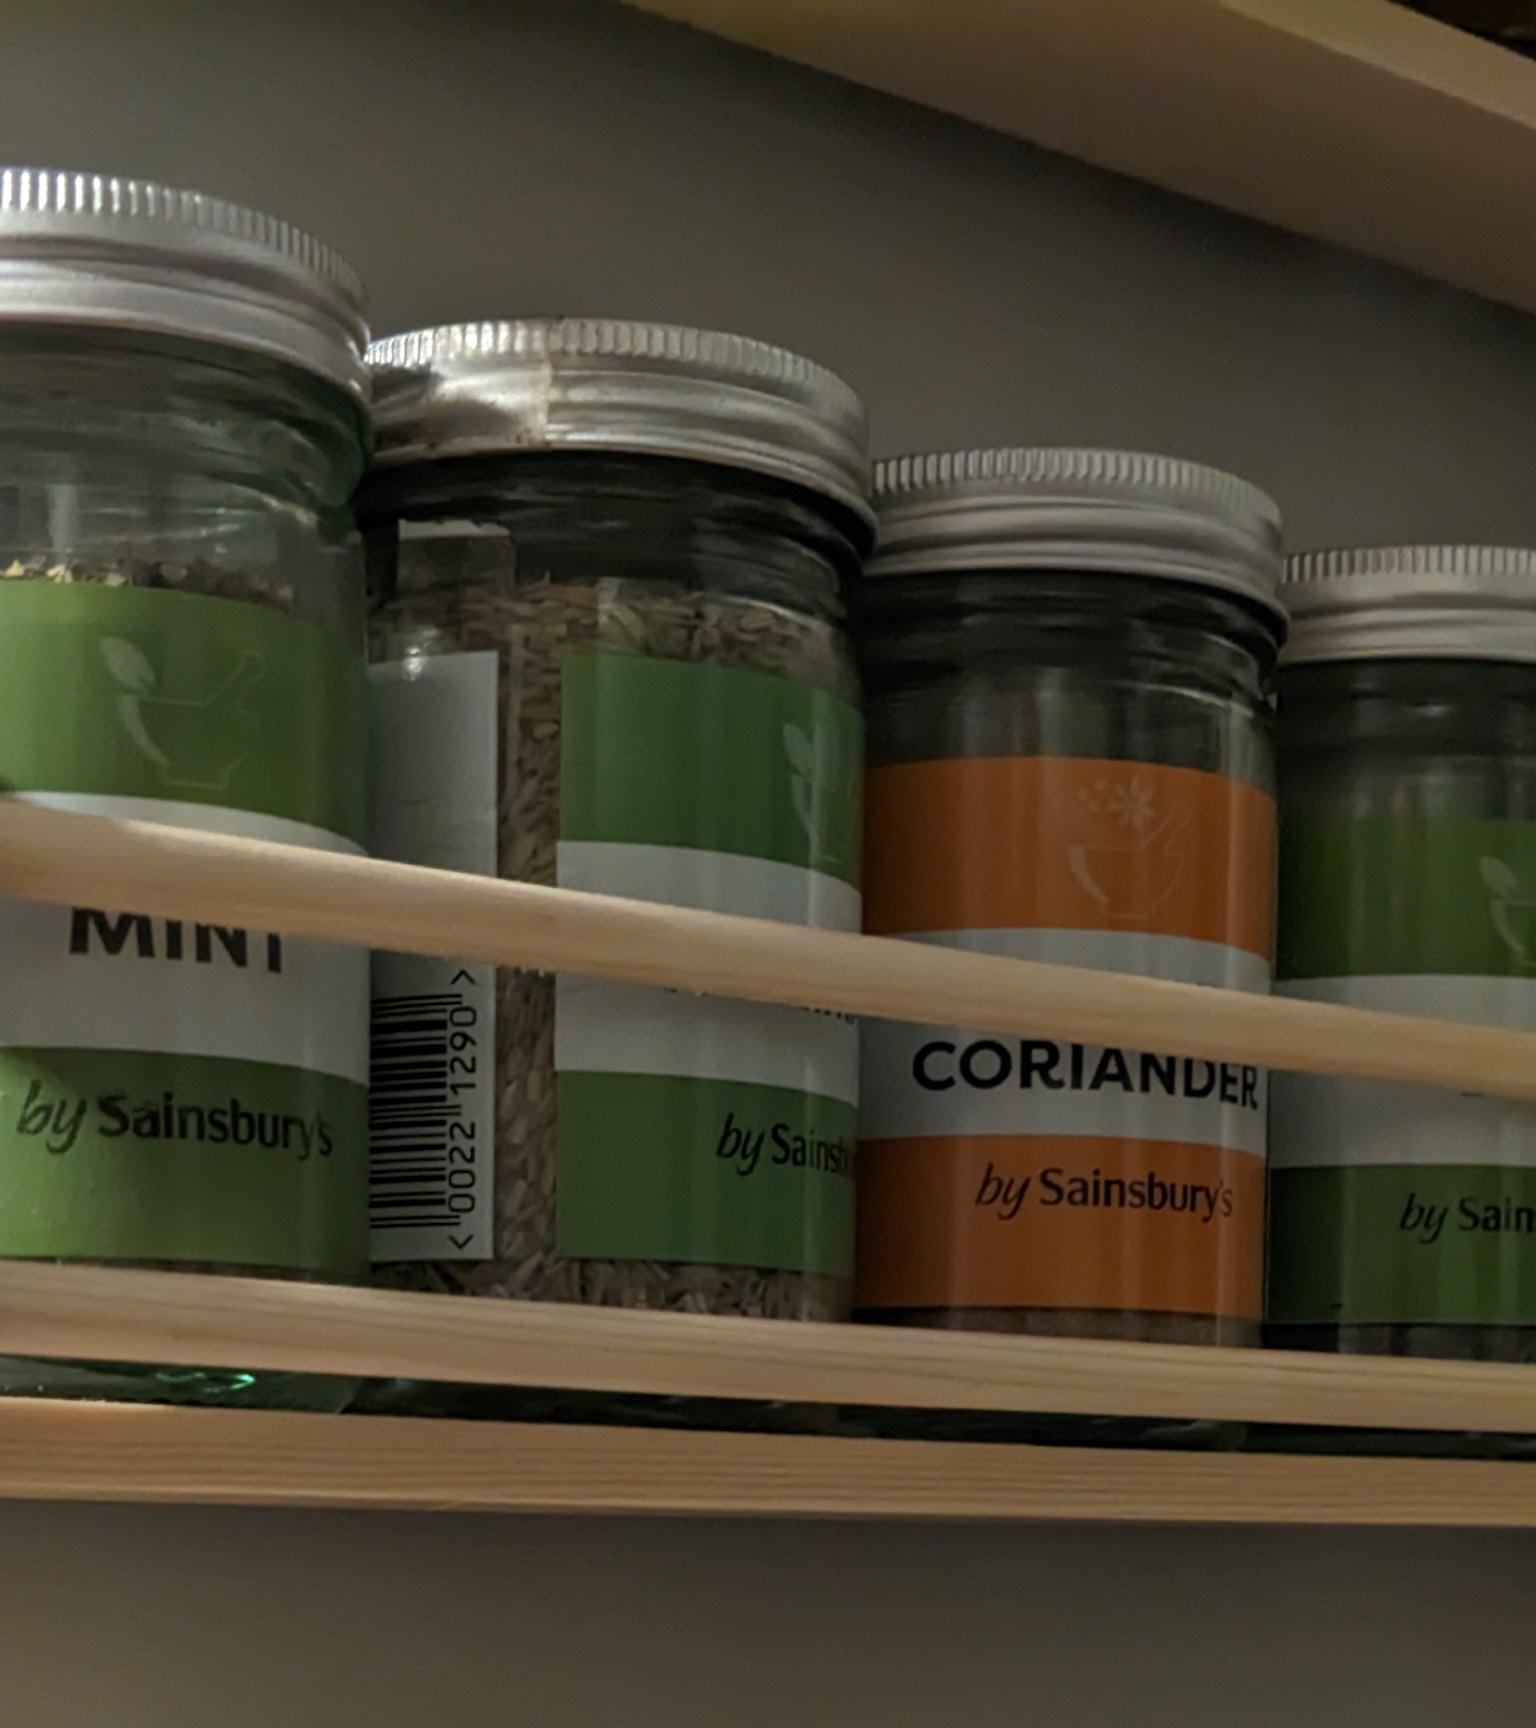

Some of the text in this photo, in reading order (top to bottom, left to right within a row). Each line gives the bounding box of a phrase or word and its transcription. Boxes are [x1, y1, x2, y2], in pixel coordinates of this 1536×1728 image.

[912, 1039, 1259, 1111] CORIANDER
[15, 1079, 334, 1161] by Sainsbury's
[447, 1005, 477, 1214] 0022 1290
[716, 1112, 765, 1177] by
[975, 1162, 1234, 1223] by Sainsbury's
[1399, 1192, 1449, 1245] by
